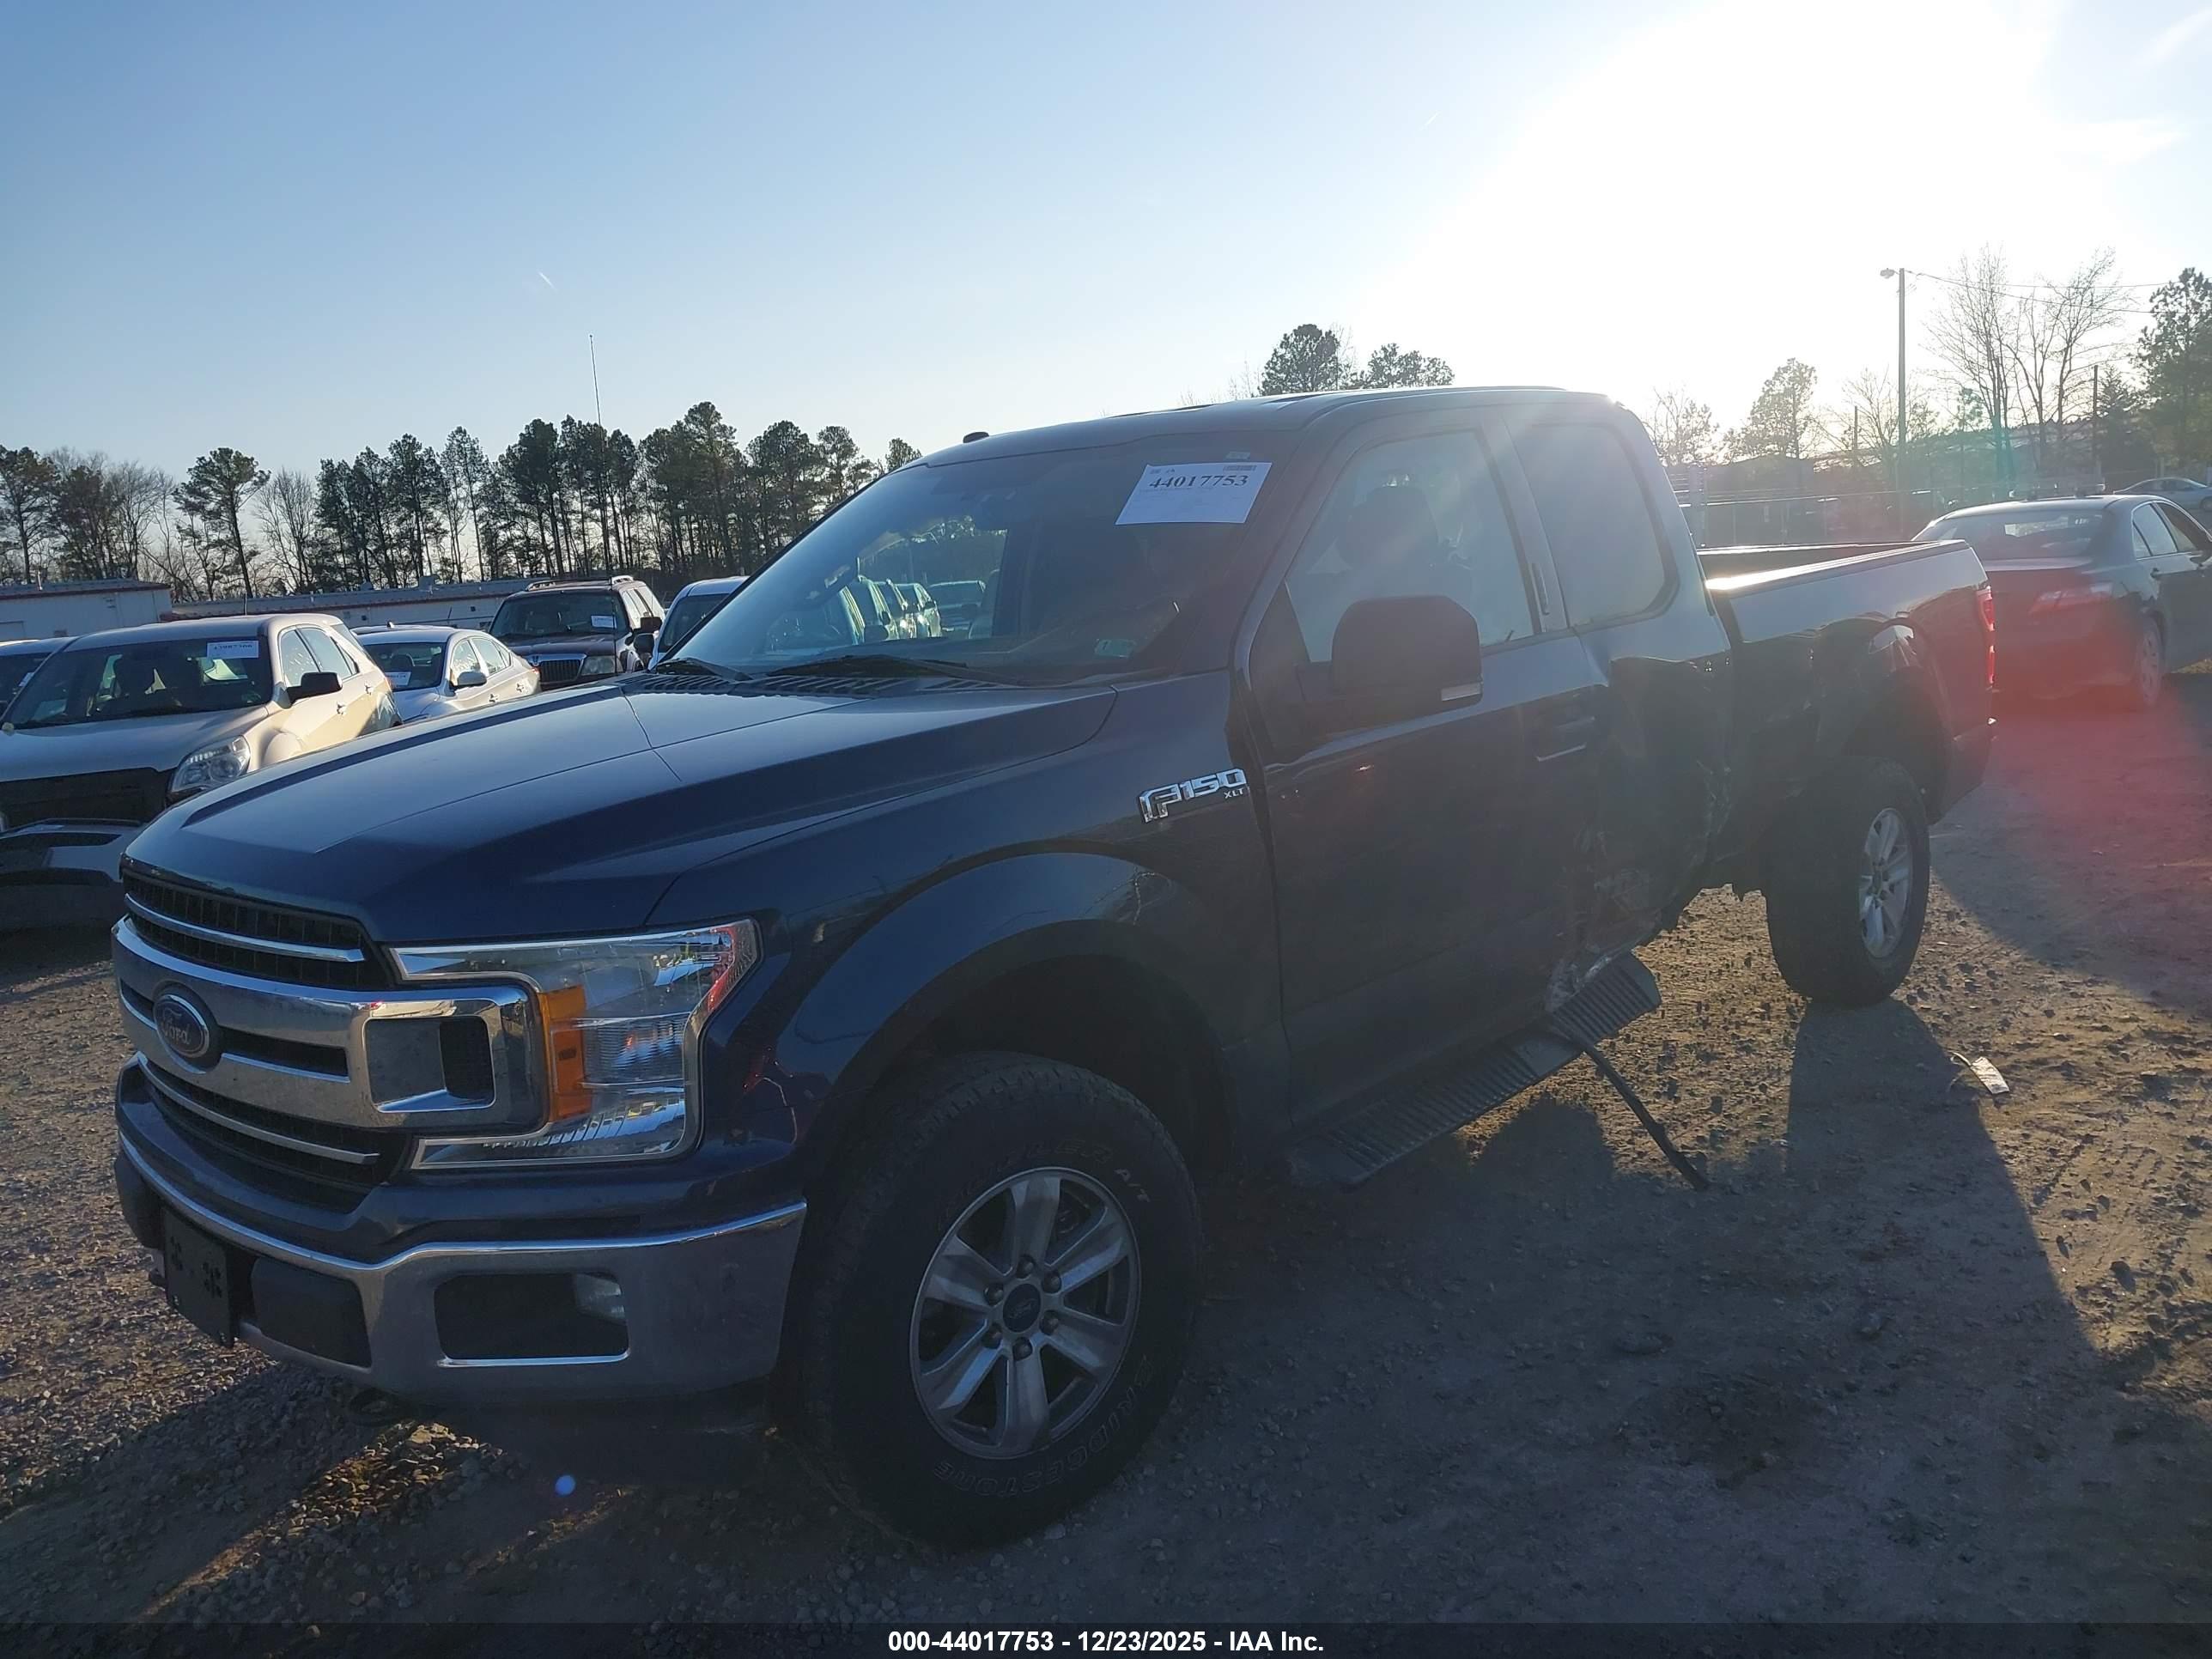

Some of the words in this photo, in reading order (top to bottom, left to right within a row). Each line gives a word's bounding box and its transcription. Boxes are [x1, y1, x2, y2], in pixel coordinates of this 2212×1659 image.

[1149, 474, 1249, 488] 44017753
[1224, 787, 1245, 799] XLT
[161, 1006, 191, 1045] Ford
